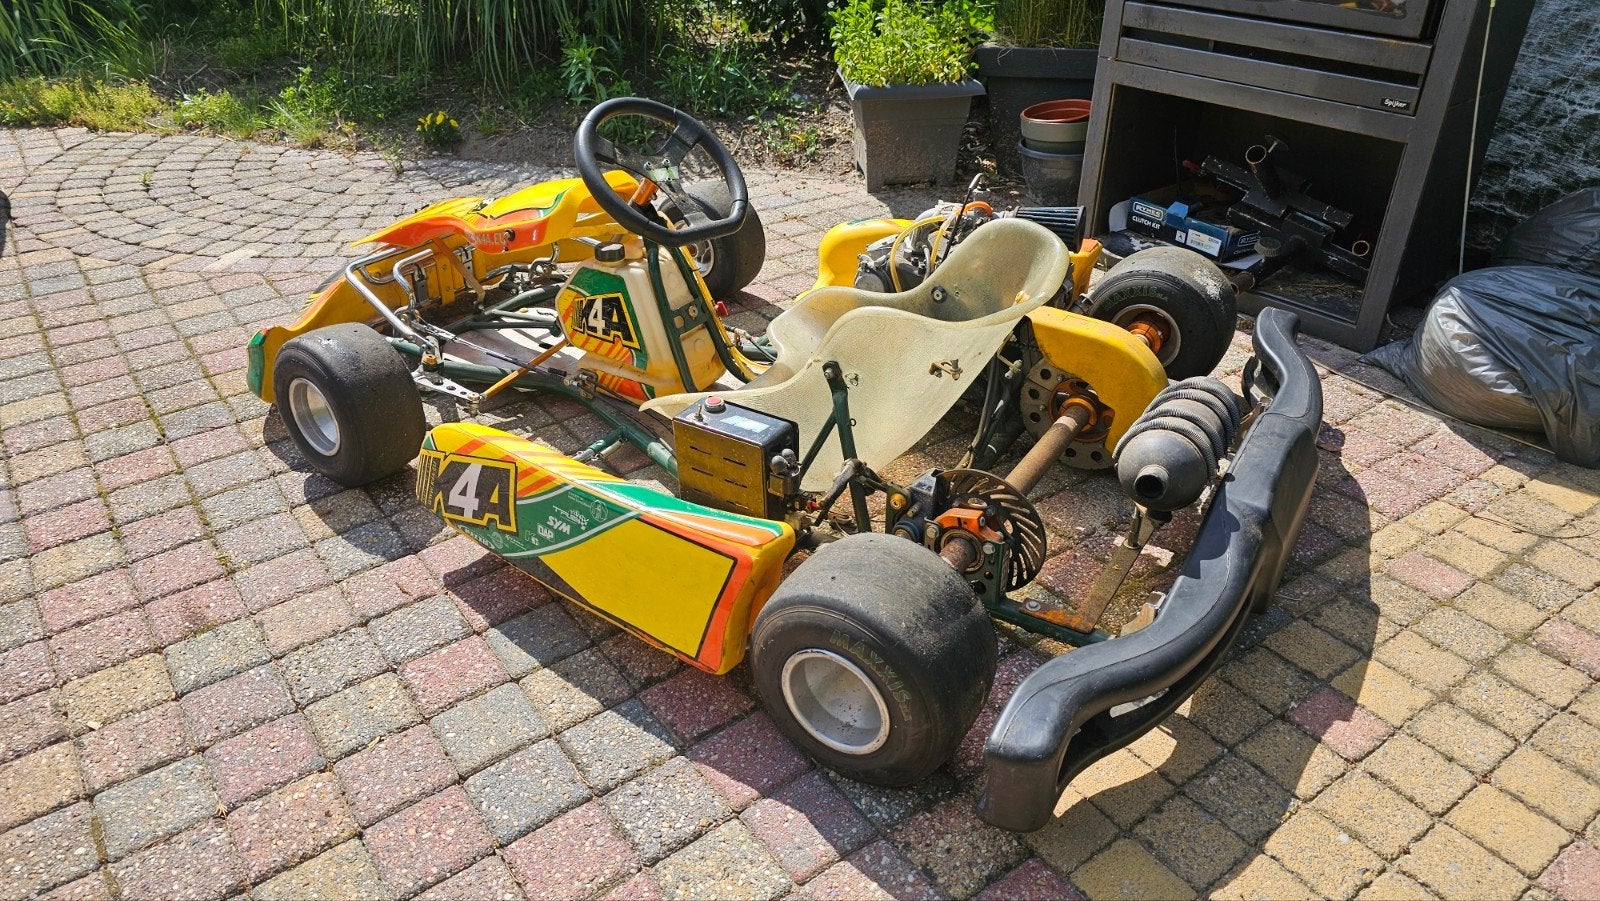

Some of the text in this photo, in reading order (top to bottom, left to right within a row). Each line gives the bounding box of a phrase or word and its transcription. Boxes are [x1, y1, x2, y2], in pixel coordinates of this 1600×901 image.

[1384, 98, 1407, 108] Spijker
[1132, 216, 1161, 230] CLUTCH KIT
[1102, 285, 1158, 311] MAXXIS
[547, 515, 571, 535] SYM
[829, 629, 913, 704] MAXXIS
